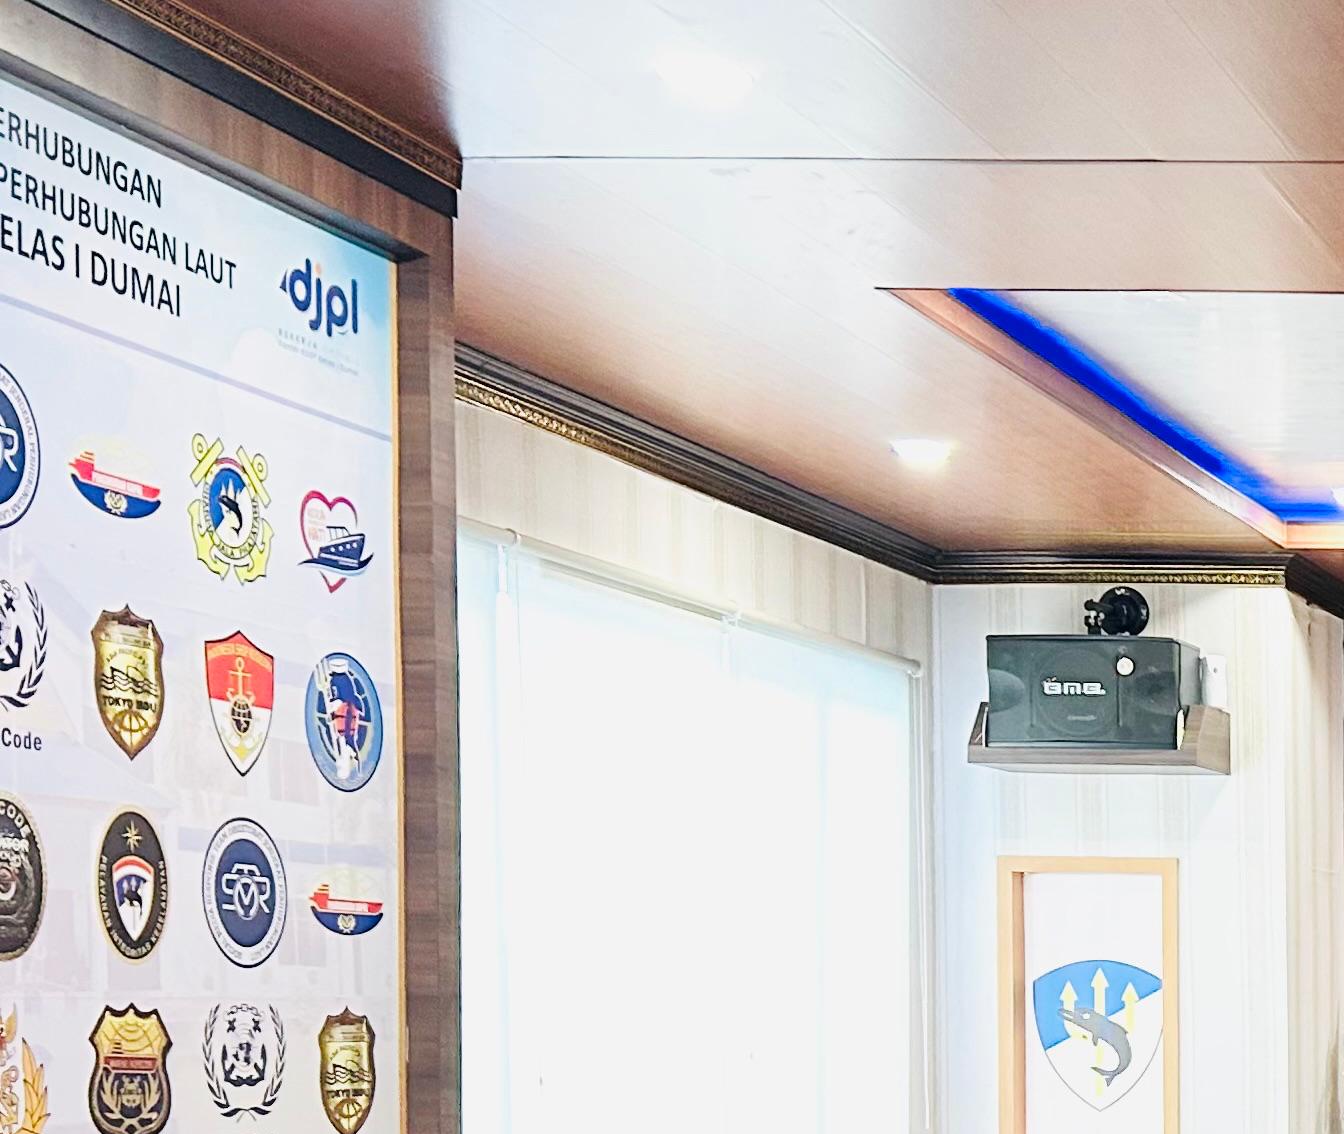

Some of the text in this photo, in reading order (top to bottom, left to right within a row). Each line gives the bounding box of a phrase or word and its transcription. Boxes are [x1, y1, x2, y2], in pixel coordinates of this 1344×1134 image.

[0, 213, 180, 317] ELAS I DUMAI
[185, 242, 237, 289] LAUT
[288, 257, 358, 337] djpl
[1, 727, 42, 751] Code
